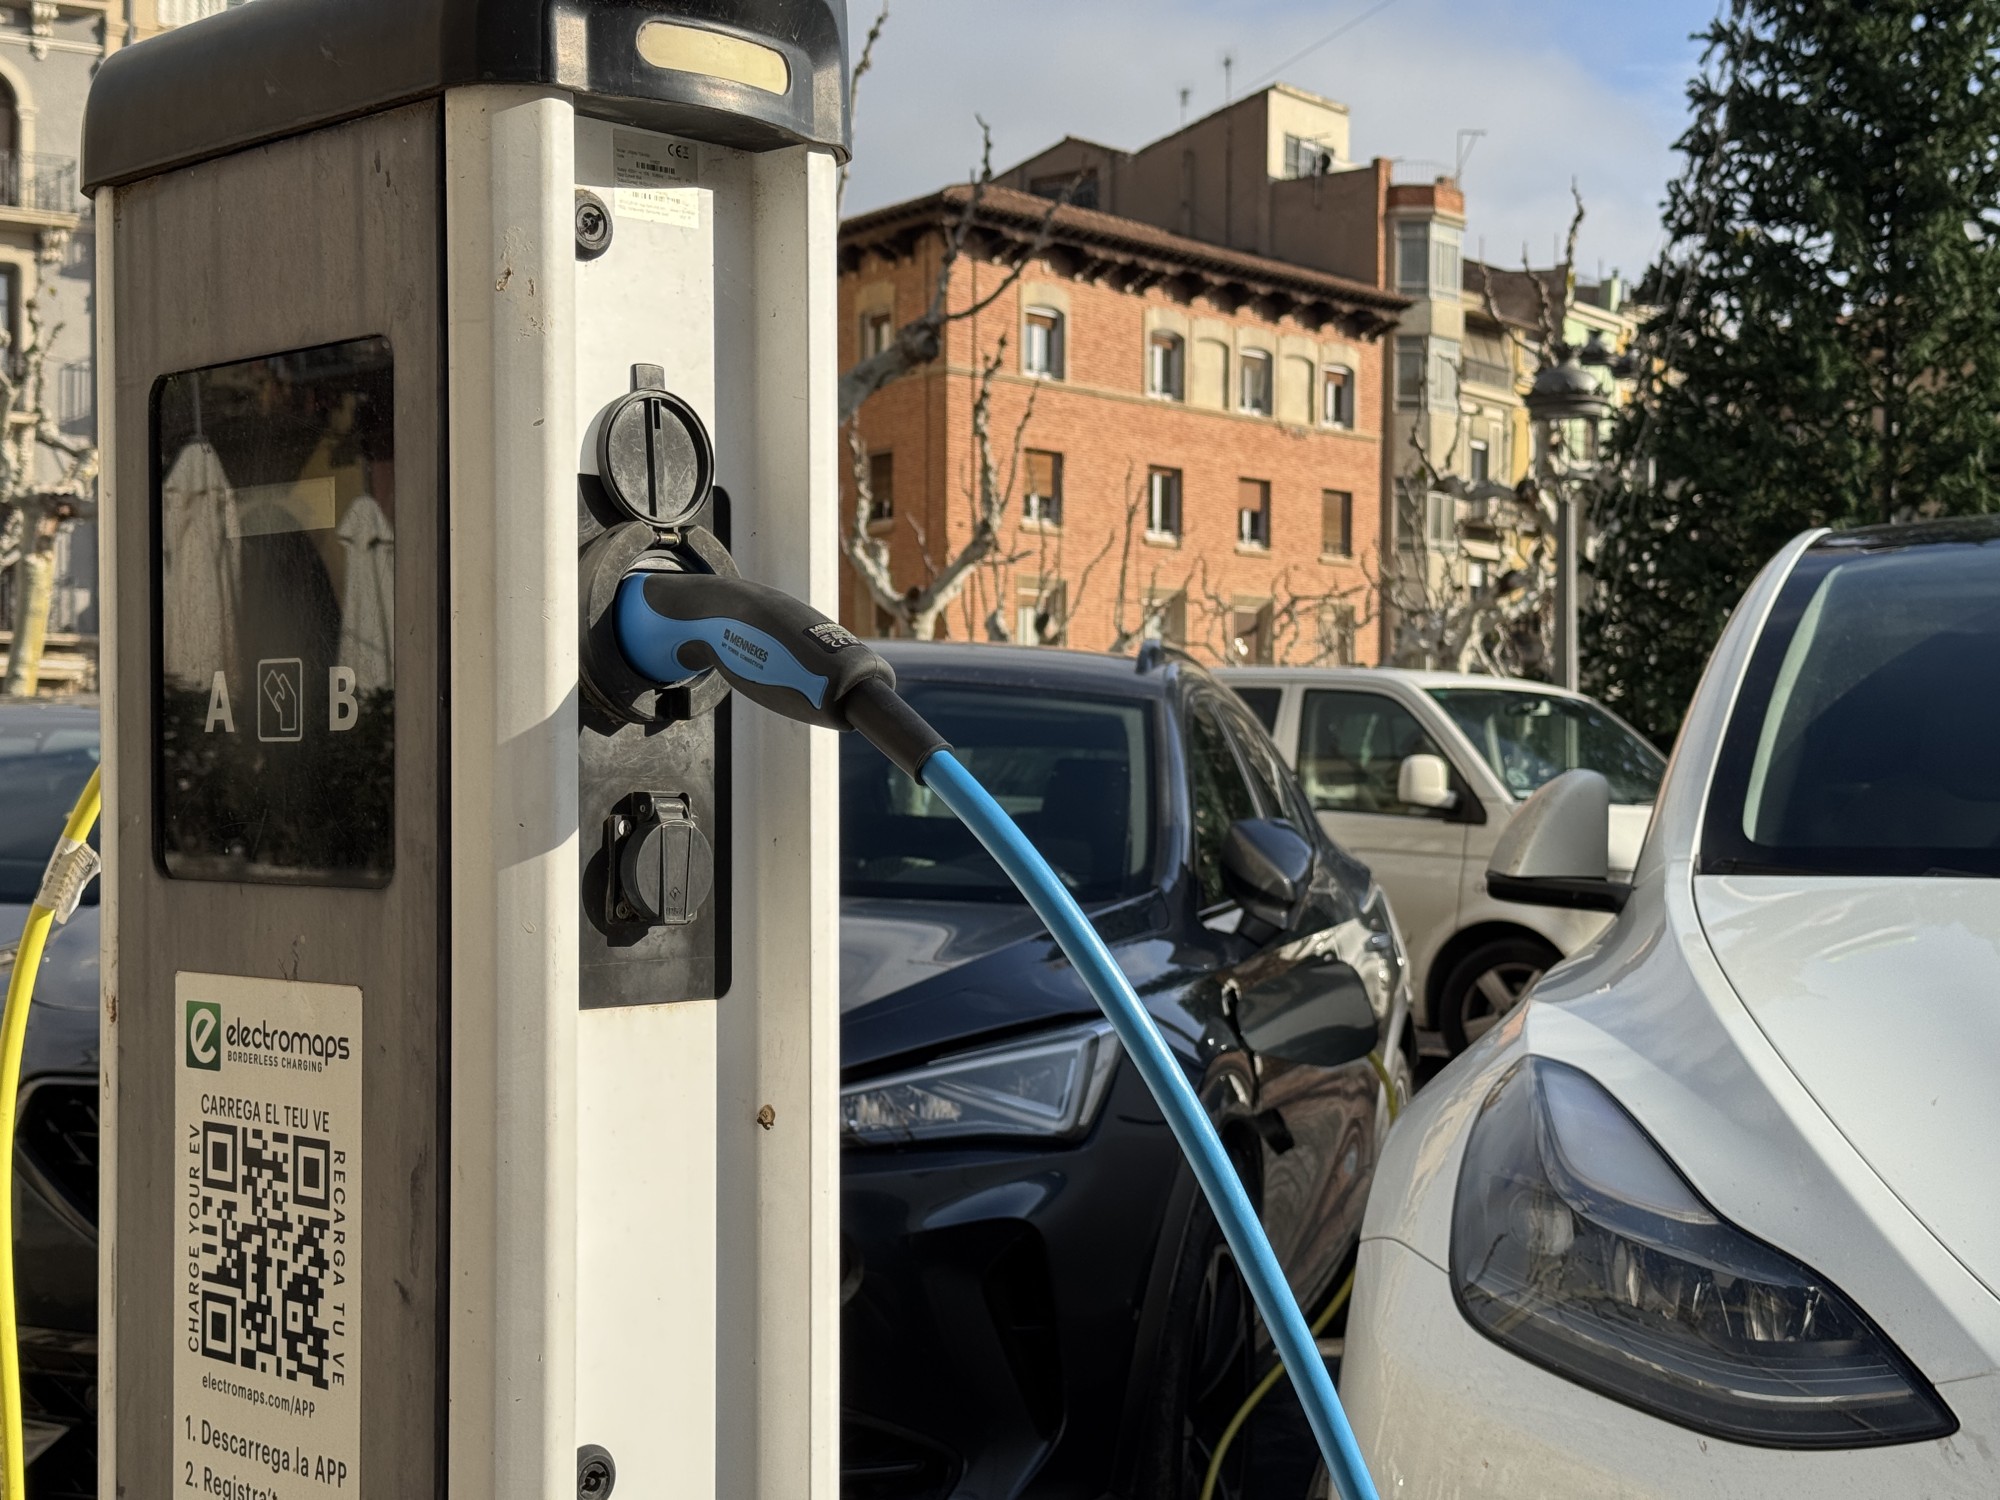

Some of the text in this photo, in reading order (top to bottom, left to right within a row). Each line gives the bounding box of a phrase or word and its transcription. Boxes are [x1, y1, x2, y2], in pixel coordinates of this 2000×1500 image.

[730, 632, 769, 663] MENNEKES
[204, 670, 235, 733] A
[329, 666, 359, 731] B
[226, 1017, 350, 1066] electromaps
[227, 1051, 323, 1073] BORDERLESS CHARGING
[201, 1094, 330, 1133] CARREGA EL TEU VE
[188, 1124, 200, 1353] CHARGE YOUR EV
[332, 1150, 346, 1386] RECARGA TU VE
[202, 1372, 316, 1419] electromaps.com/APP
[185, 1414, 196, 1442] 1.
[201, 1419, 290, 1474] Descarrega
[314, 1455, 347, 1489] APP
[185, 1461, 198, 1489] 2.
